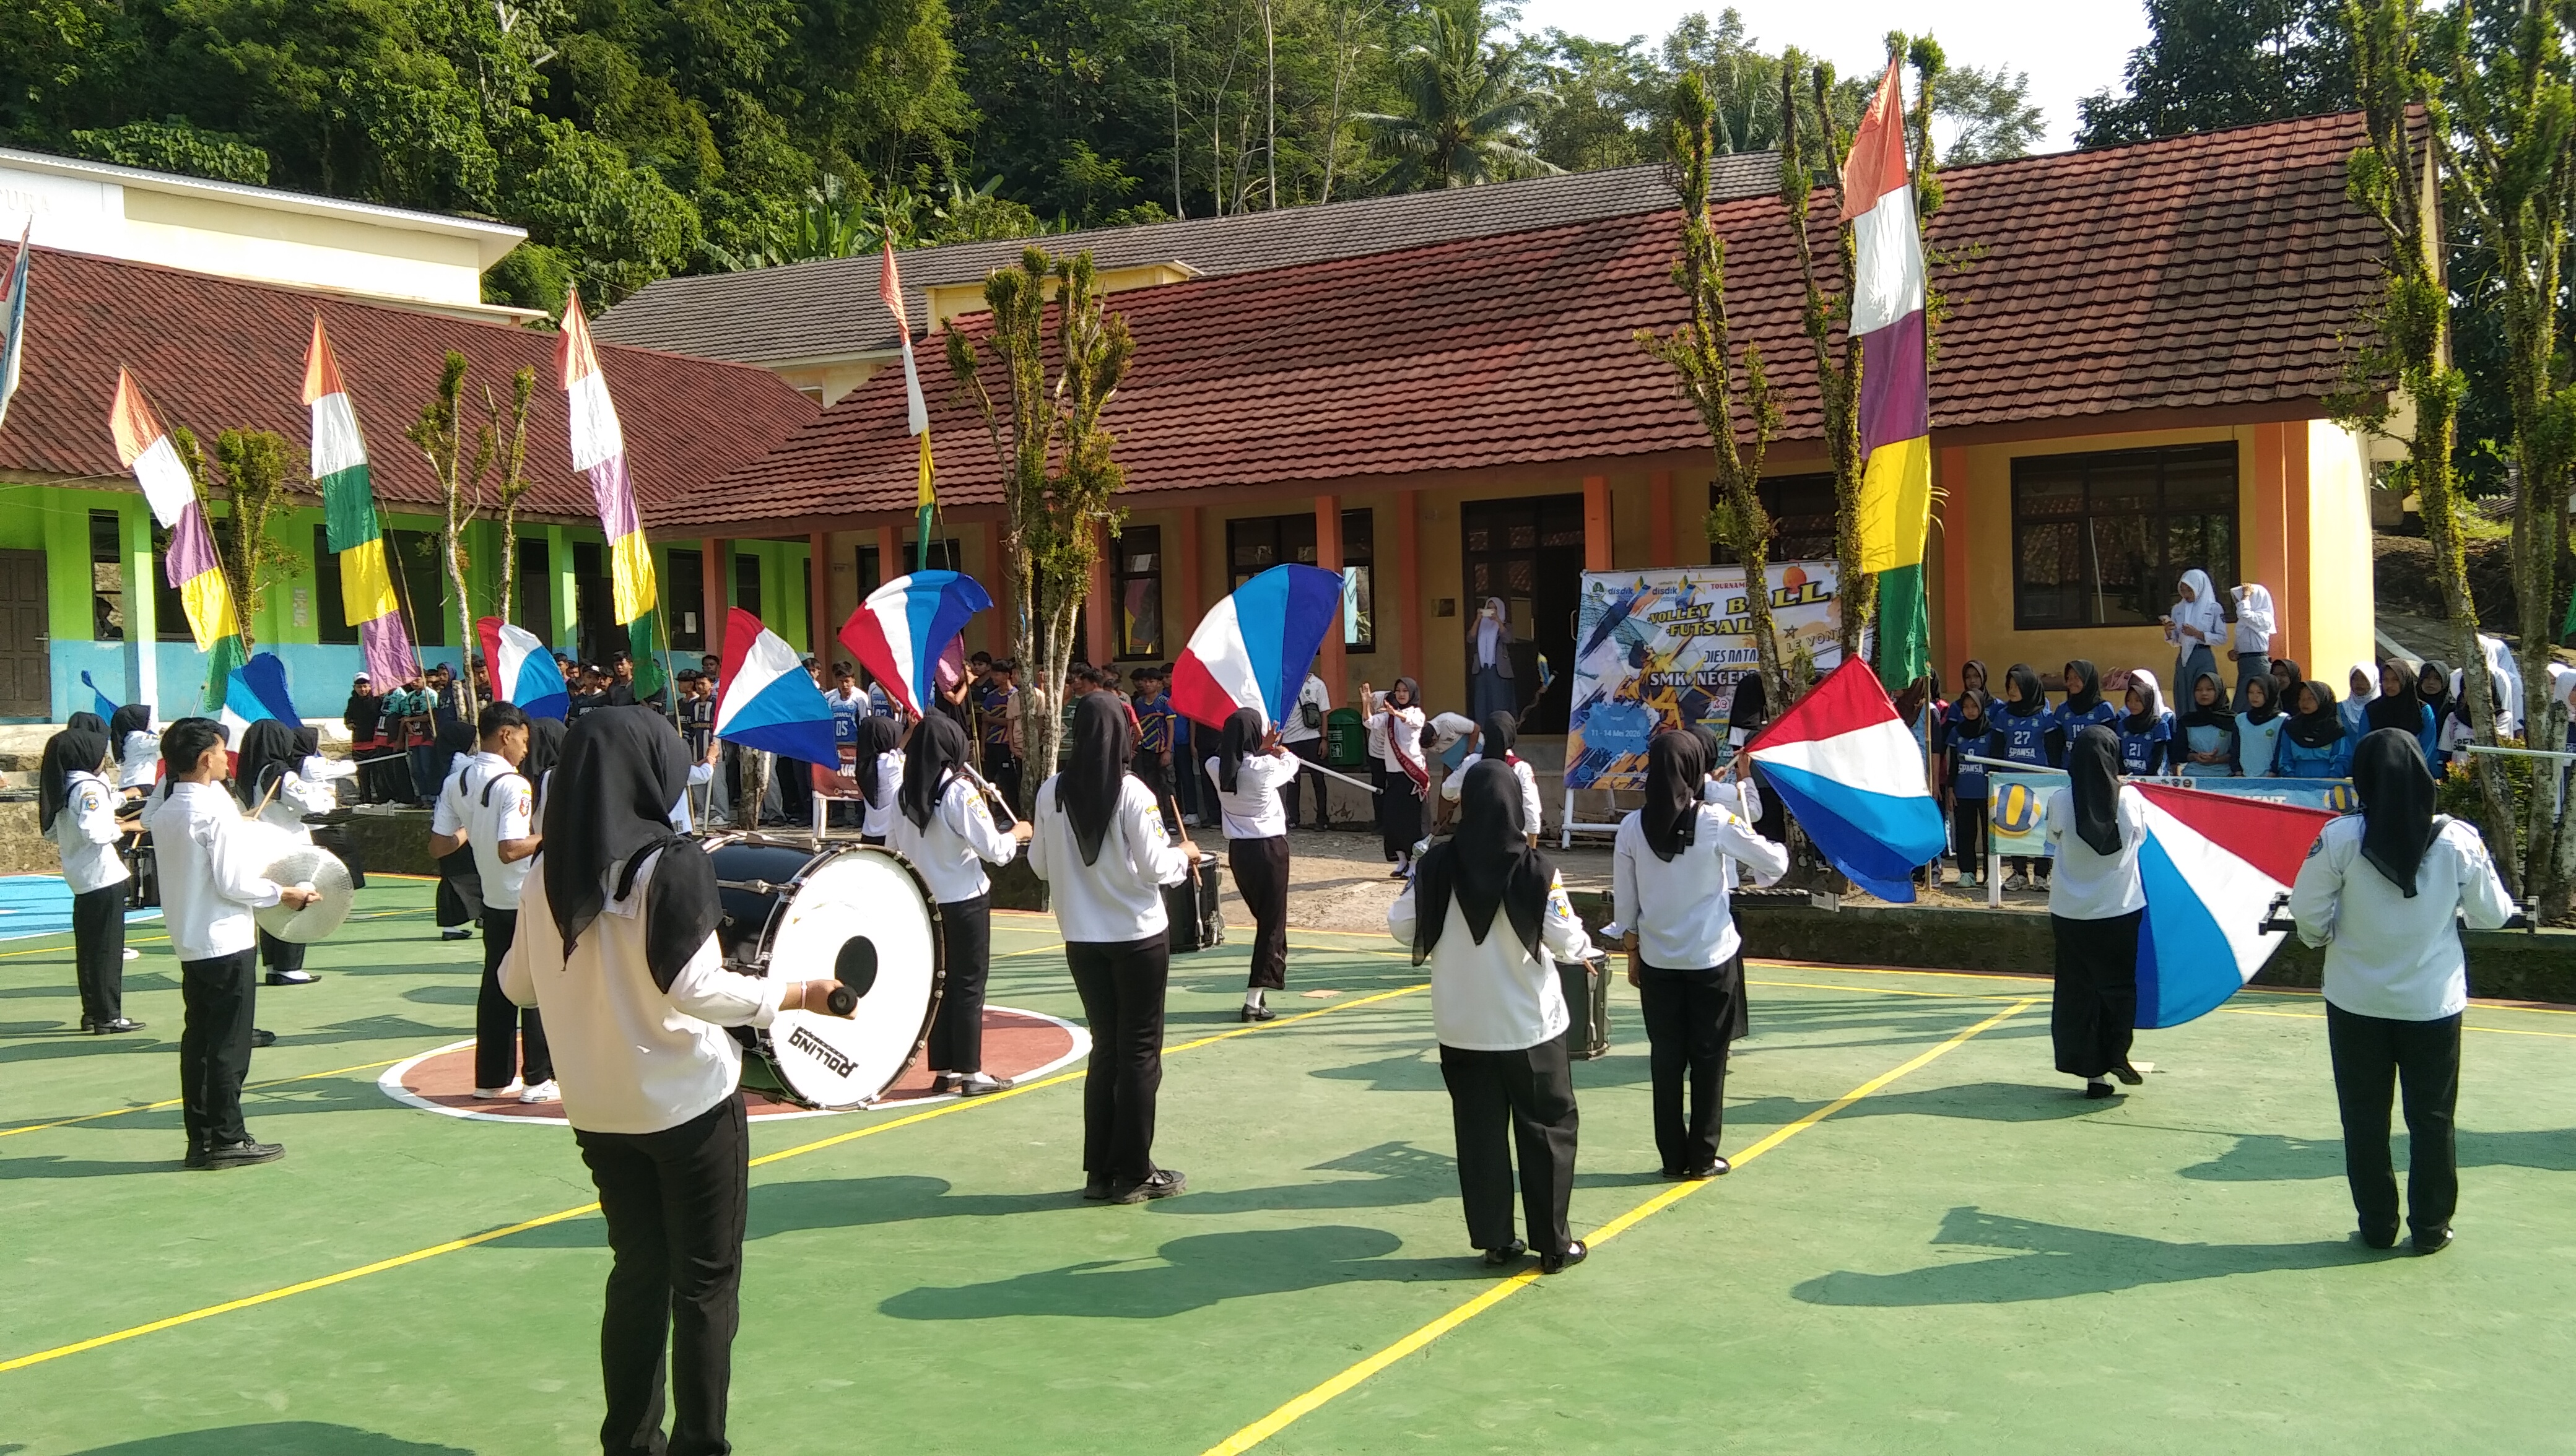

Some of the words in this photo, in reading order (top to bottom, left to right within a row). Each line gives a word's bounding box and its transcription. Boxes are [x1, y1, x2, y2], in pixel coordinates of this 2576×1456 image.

[1652, 587, 1677, 595] disdik
[1650, 602, 1714, 624] VOLLEY
[1726, 581, 1831, 615] BLL
[1669, 617, 1754, 636] FUTSAL
[1806, 628, 1843, 646] VONT
[1728, 649, 1759, 662] NATA
[1650, 672, 1687, 686] SMK
[836, 721, 848, 736] 05
[2014, 730, 2031, 745] 27
[2008, 747, 2036, 758] SPANSA
[2129, 743, 2141, 756] 21
[1958, 763, 1983, 774] SPANSA
[788, 1026, 859, 1078] ROLLING
